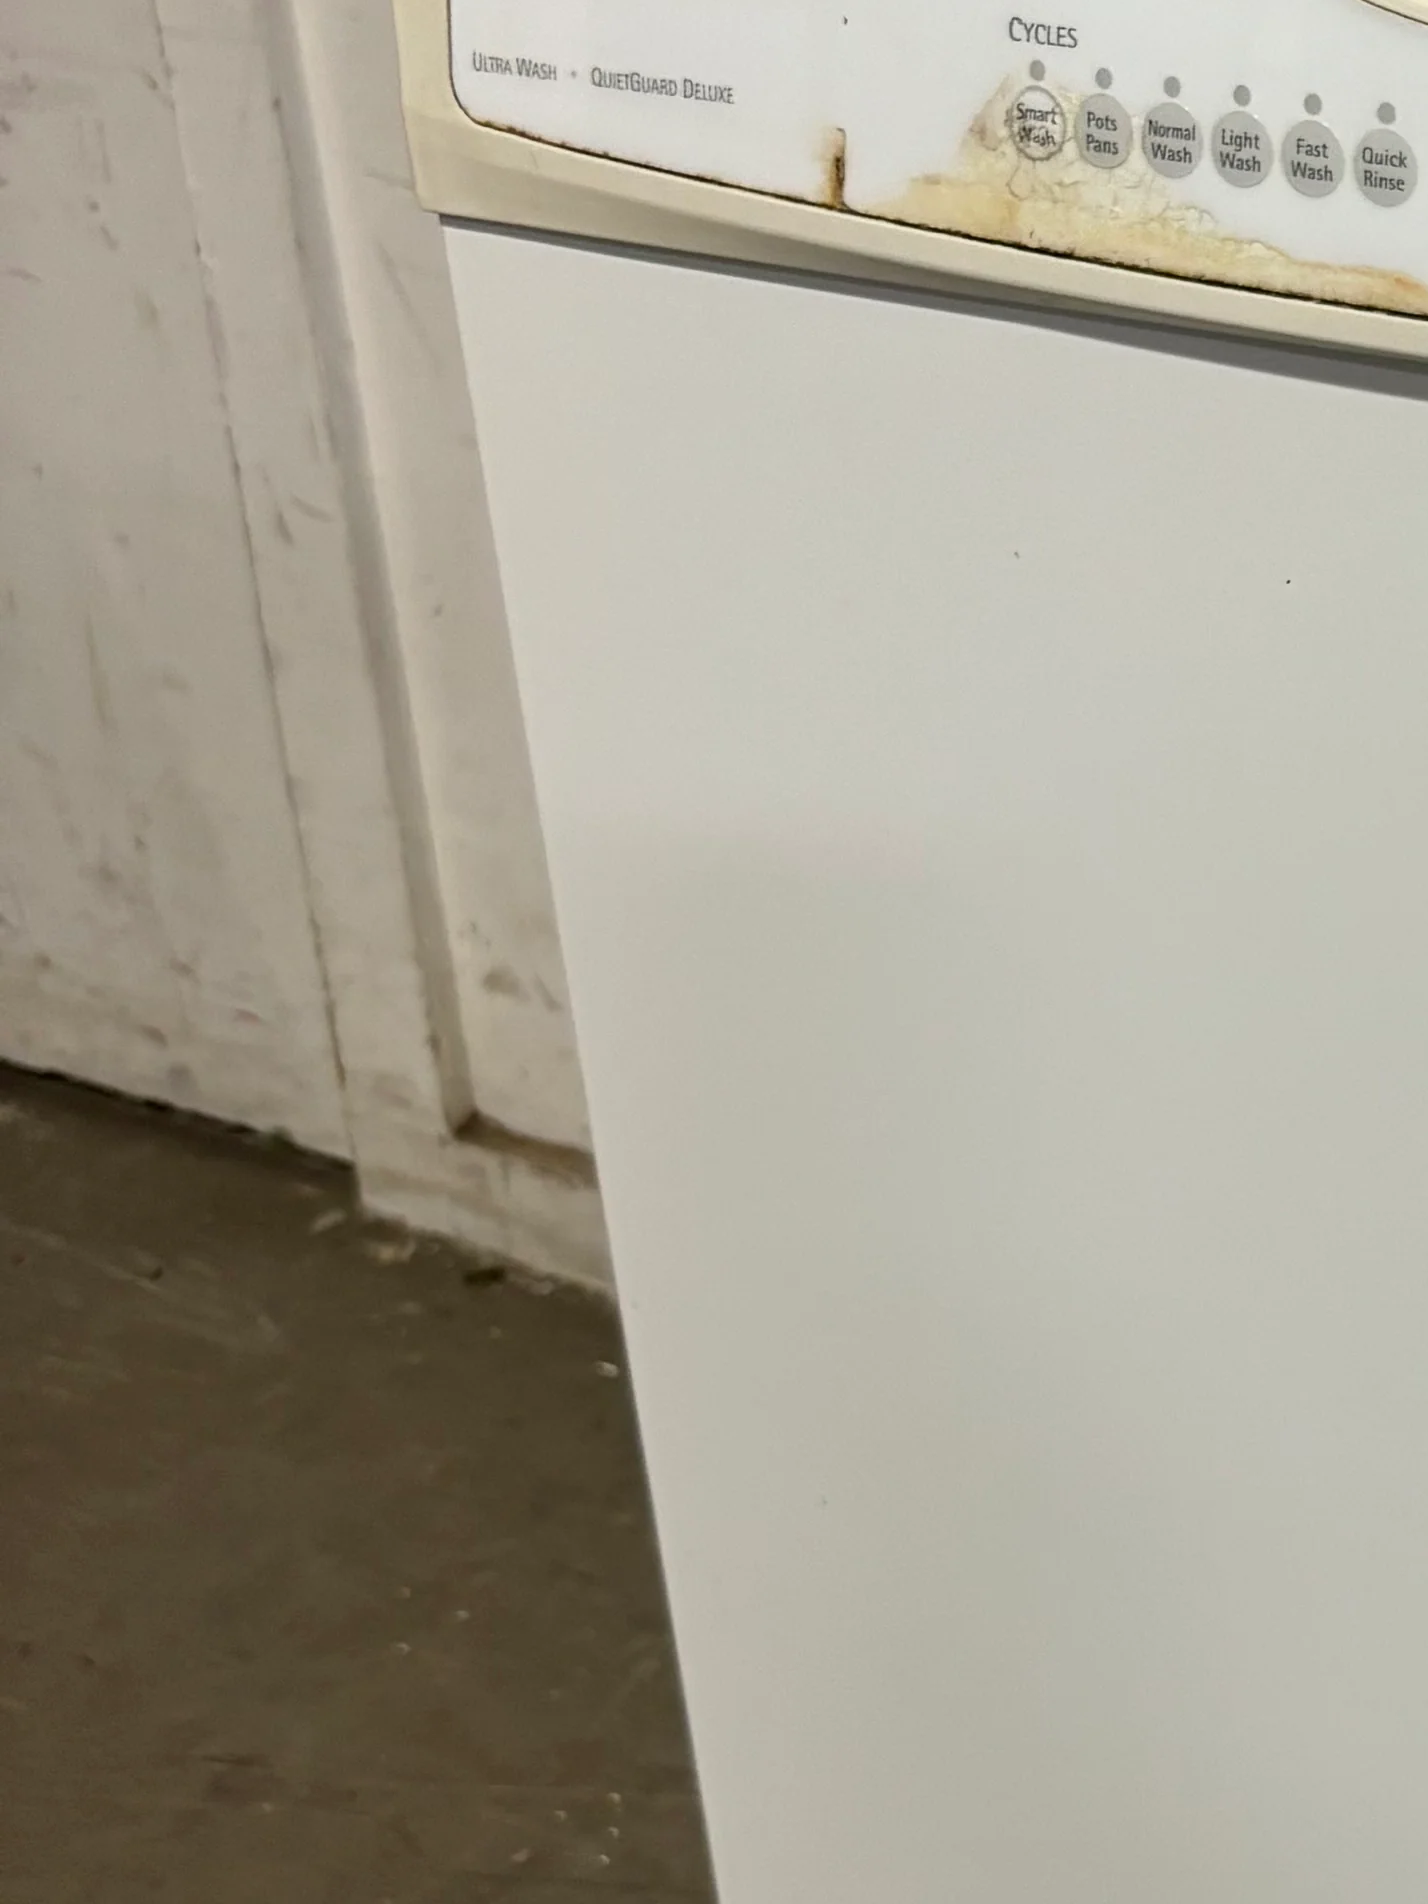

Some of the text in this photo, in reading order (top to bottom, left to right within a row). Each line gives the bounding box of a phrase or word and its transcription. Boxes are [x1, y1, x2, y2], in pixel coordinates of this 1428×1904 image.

[1016, 103, 1058, 126] Smart
[1087, 111, 1118, 132] Pots
[1017, 126, 1056, 148] Wash
[1148, 119, 1196, 141] Normal
[1221, 128, 1260, 151] Light
[1086, 135, 1119, 155] Pans
[1151, 142, 1192, 164] Wash
[1296, 138, 1329, 160] Fast
[1219, 151, 1261, 173] Wash
[1362, 147, 1407, 169] Quick
[1290, 160, 1333, 182] Wash
[1364, 170, 1405, 192] Rinse
